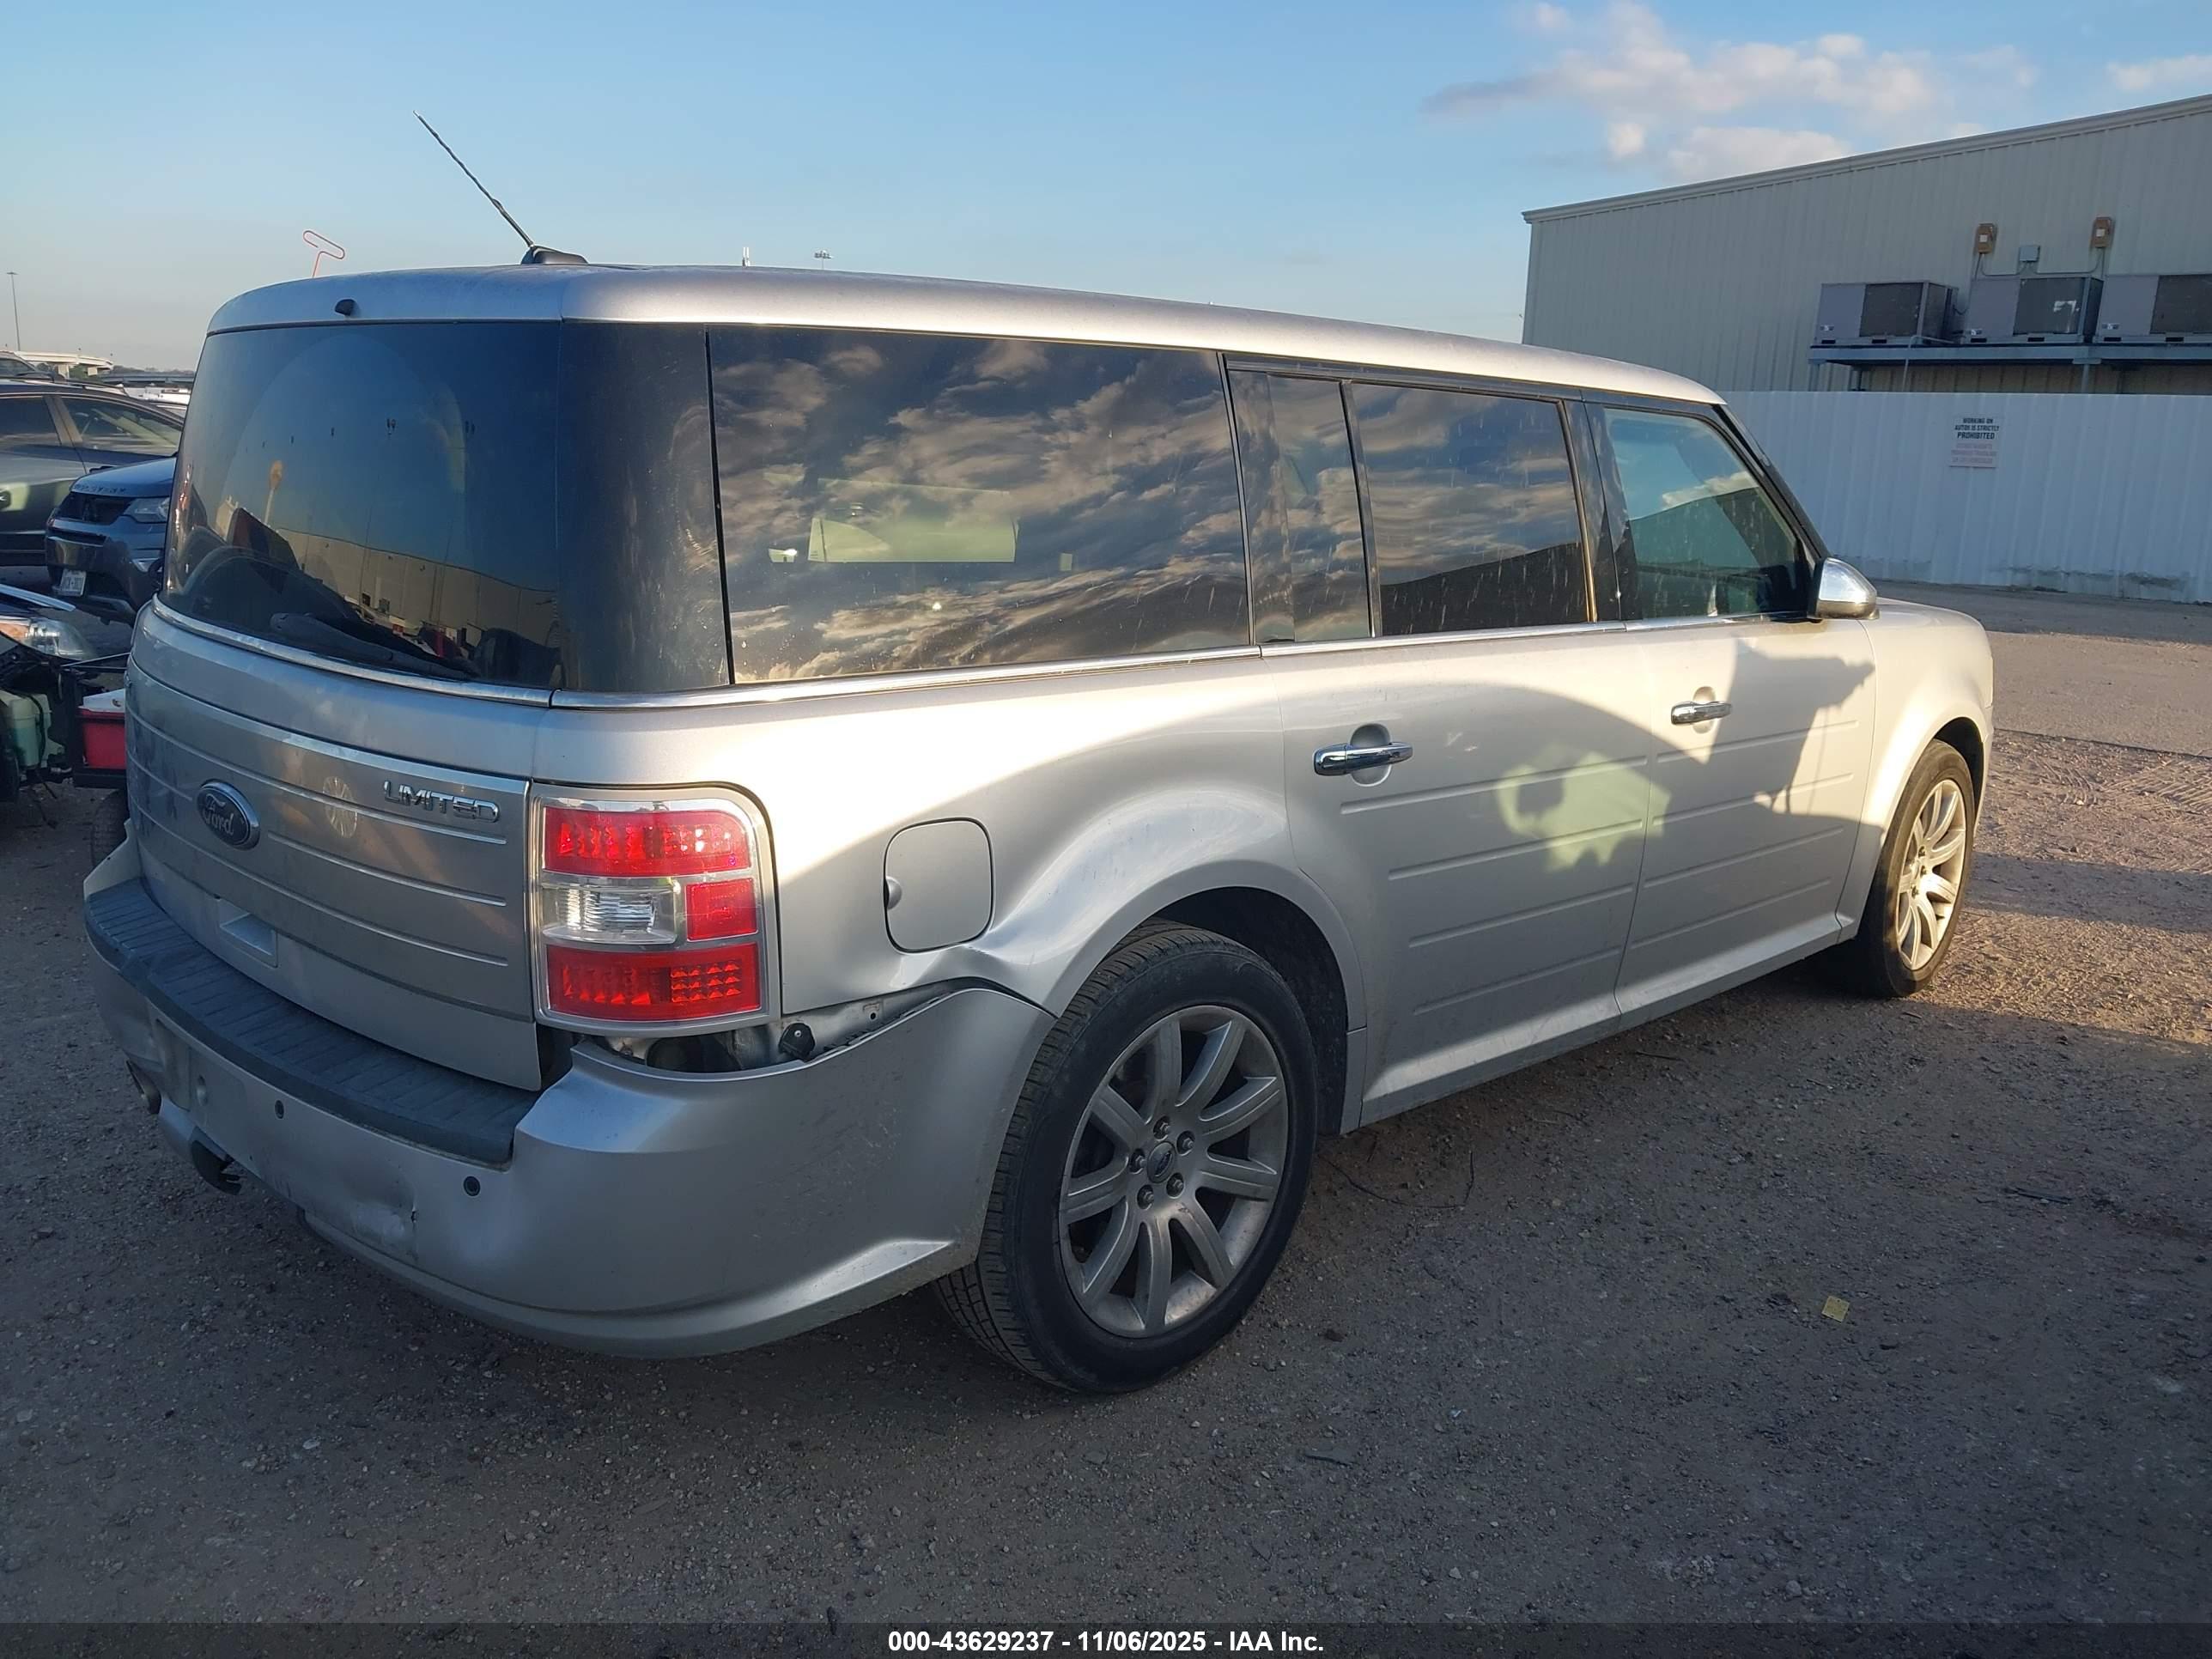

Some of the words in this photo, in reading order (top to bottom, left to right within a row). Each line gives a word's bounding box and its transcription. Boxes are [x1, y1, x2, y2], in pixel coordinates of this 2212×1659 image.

[1957, 431, 1996, 440] PROHIBITED
[202, 793, 235, 836] Ford
[383, 780, 500, 823] LIMITED
